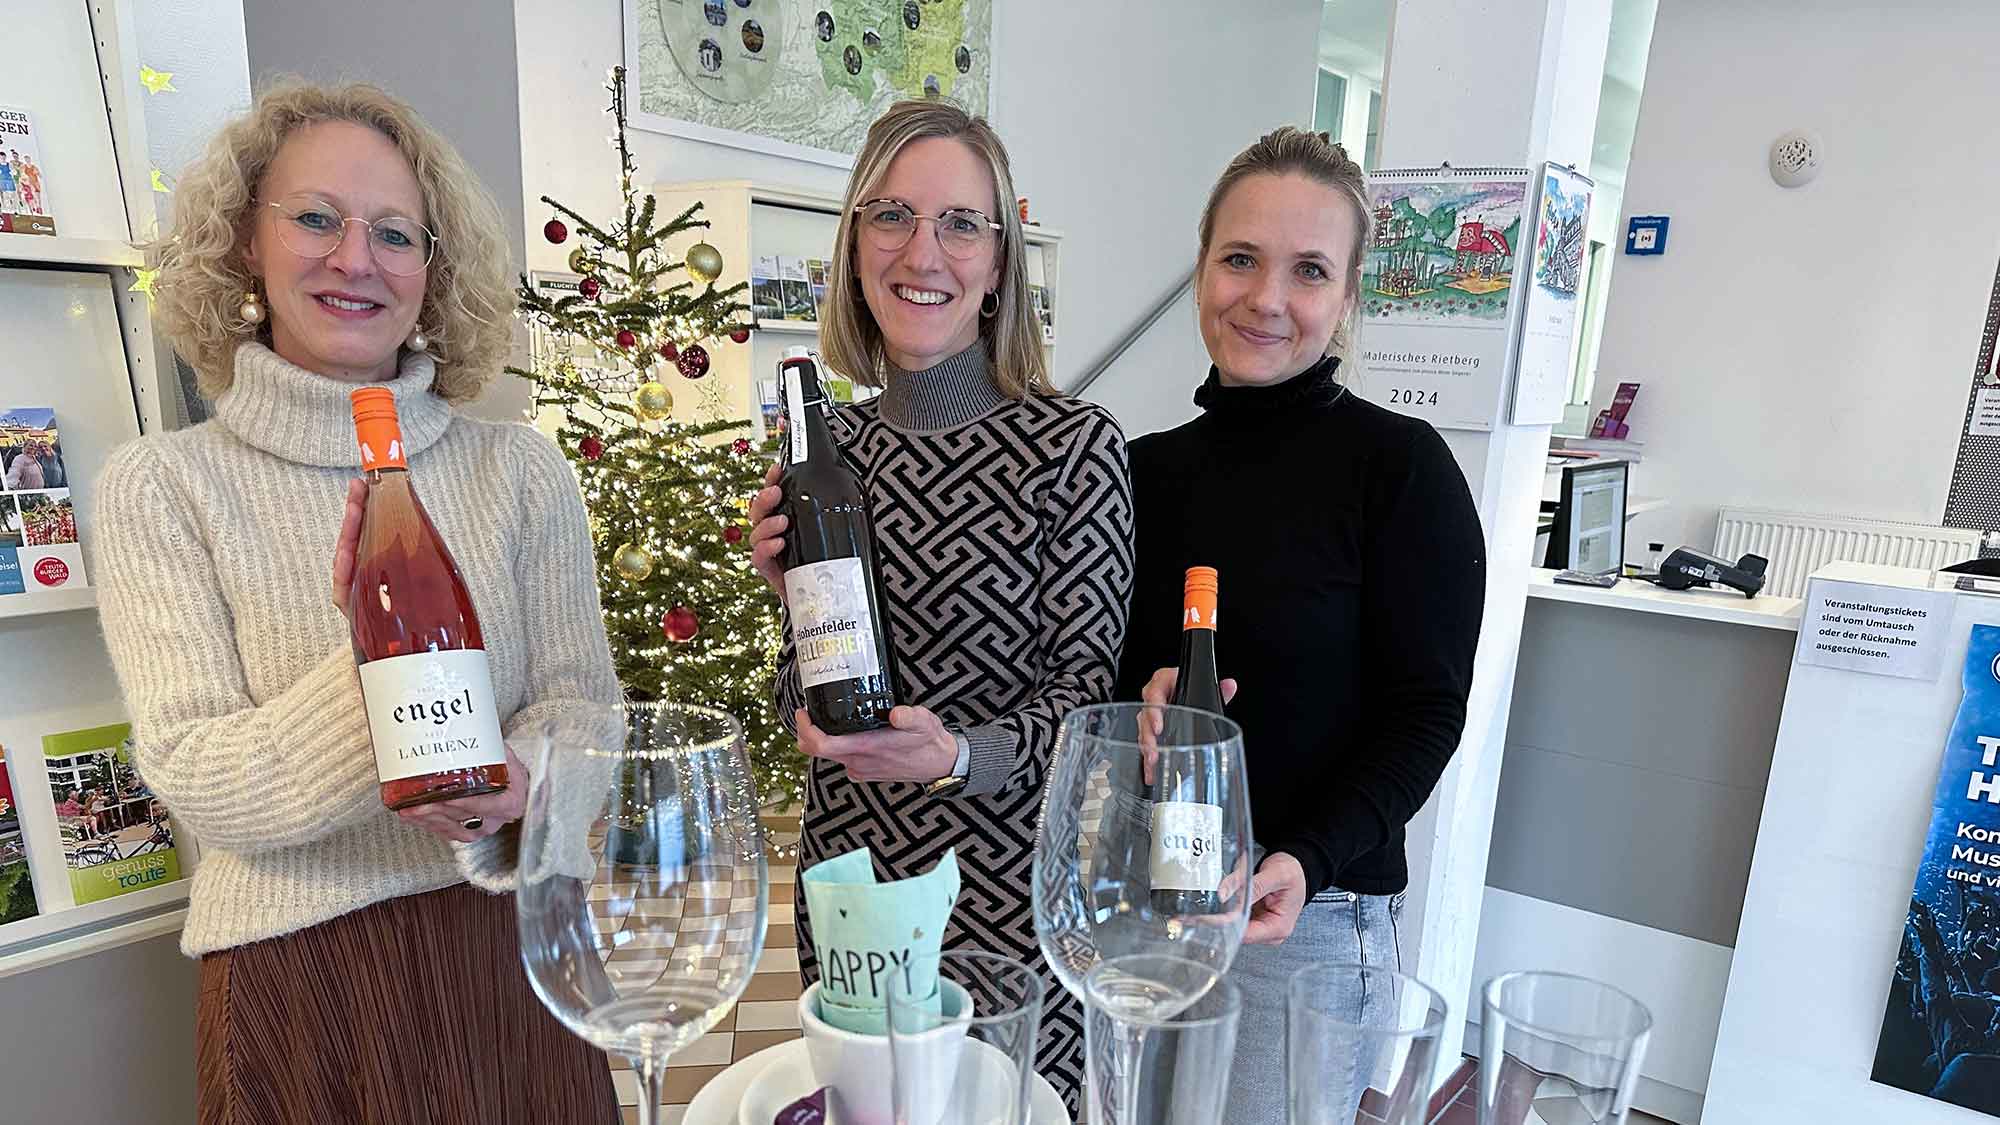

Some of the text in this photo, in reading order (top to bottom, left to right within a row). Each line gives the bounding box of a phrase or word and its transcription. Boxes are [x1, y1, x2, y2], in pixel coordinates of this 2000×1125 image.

[1361, 351, 1480, 368] Malerisches Rietberg
[1390, 389, 1438, 406] 2024
[1824, 599, 1927, 618] Veranstaltungstickets
[1821, 614, 1914, 631] sind vom Umtausch
[1818, 628, 1917, 647] oder der Rücknahme
[1816, 643, 1890, 659] ausgeschlossen.
[393, 688, 473, 725] engel
[399, 737, 479, 760] LAURENZ
[1163, 833, 1216, 857] engel
[1951, 844, 2000, 869] Mus
[102, 855, 166, 882] genuss
[118, 867, 167, 888] route
[1946, 867, 1981, 885] und
